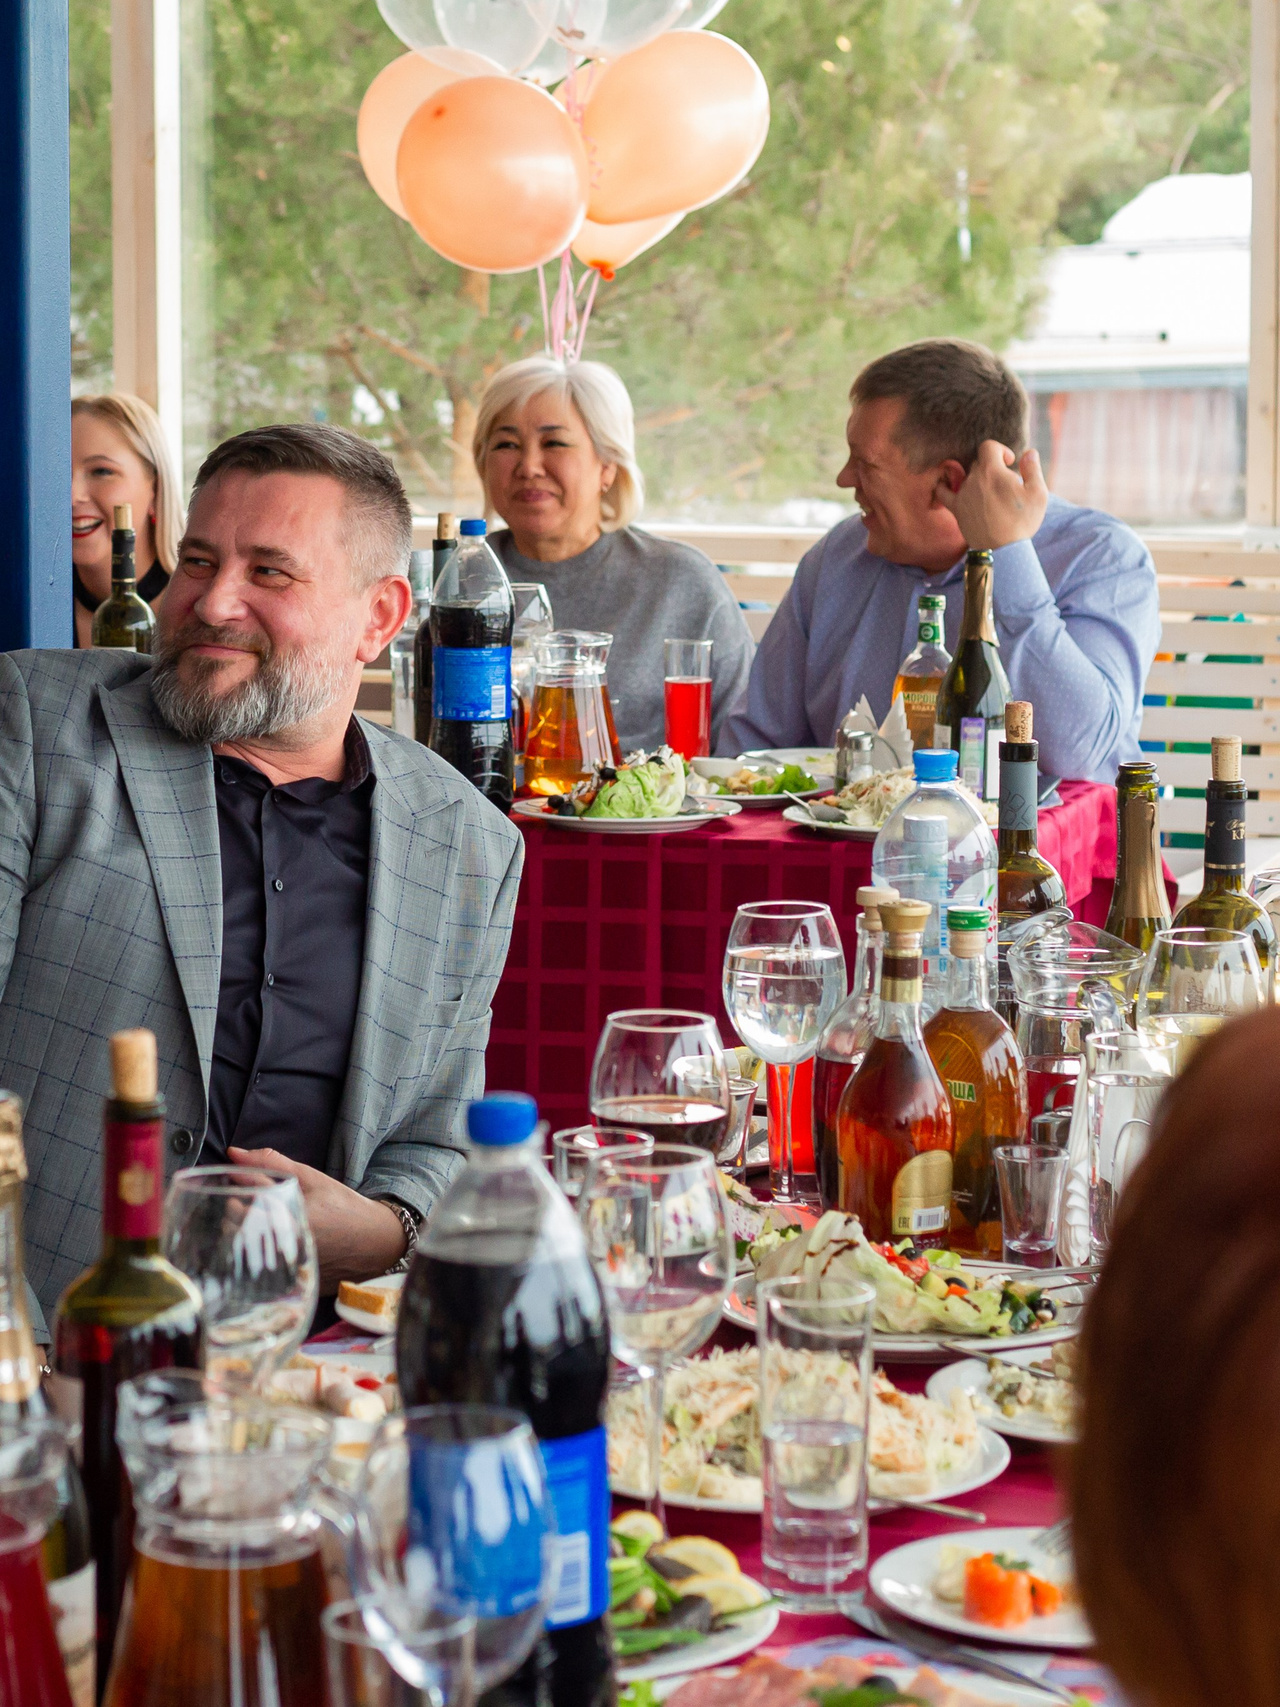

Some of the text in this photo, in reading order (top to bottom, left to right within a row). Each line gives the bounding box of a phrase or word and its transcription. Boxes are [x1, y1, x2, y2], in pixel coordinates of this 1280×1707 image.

[903, 692, 937, 704] МОРОШ
[1232, 829, 1245, 840] КР
[946, 1080, 976, 1102] ОША
